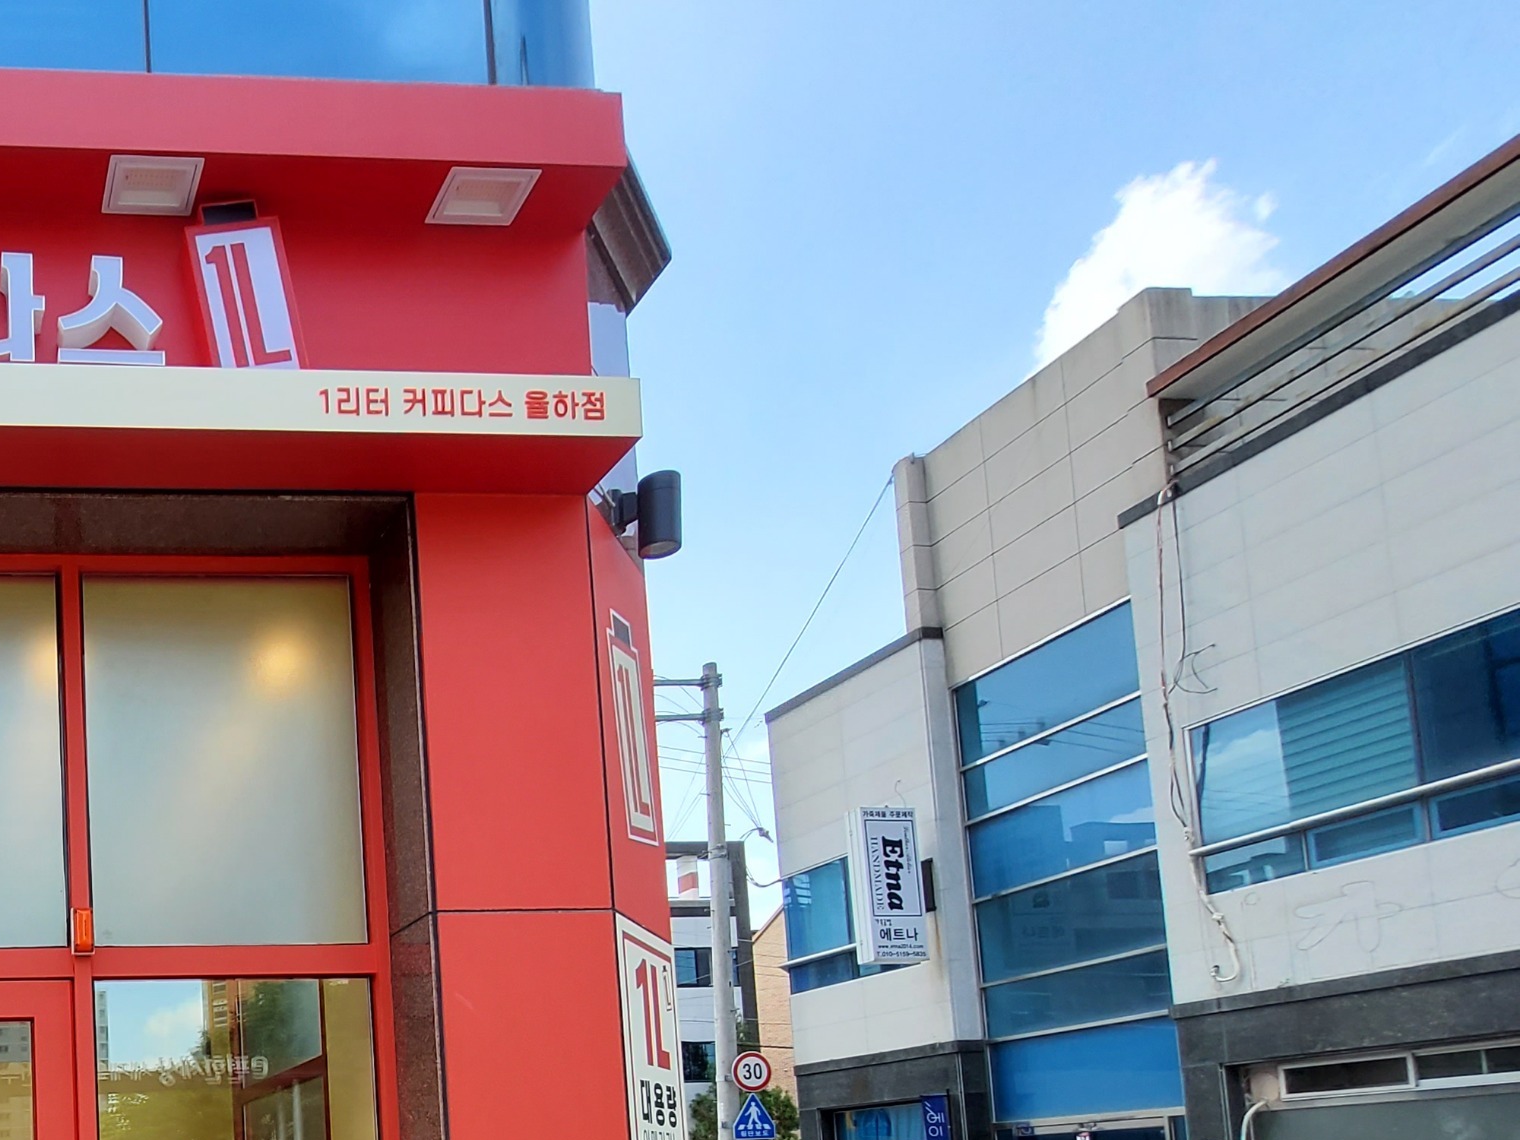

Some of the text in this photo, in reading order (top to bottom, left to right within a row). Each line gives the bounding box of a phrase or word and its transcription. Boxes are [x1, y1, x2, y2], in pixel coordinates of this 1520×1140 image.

[204, 242, 293, 369] 1L
[318, 386, 390, 418] 1리터
[402, 387, 514, 419] 커피다스
[882, 835, 904, 911] Etna
[879, 927, 918, 941] 에트나
[742, 1063, 764, 1080] 30
